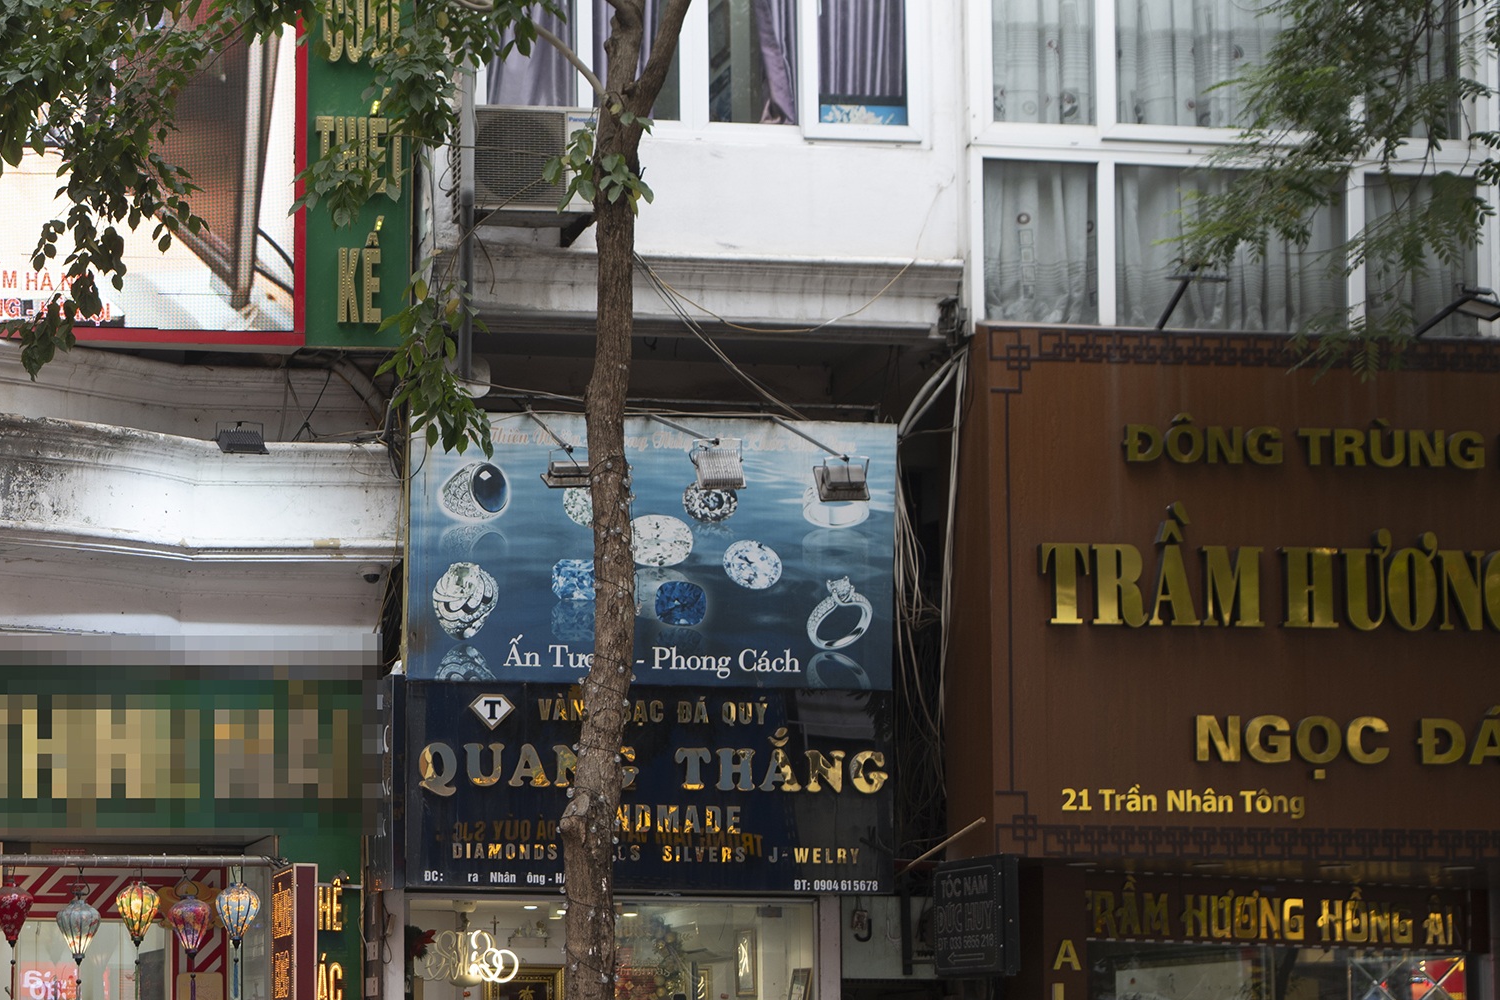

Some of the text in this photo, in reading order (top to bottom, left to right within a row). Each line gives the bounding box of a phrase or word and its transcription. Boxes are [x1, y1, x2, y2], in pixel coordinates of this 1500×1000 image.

[337, 215, 384, 323] KẾ
[1122, 412, 1485, 469] ĐÔNG TRÙNG
[1037, 502, 1265, 629] TRẦM
[503, 635, 541, 668] Ấn
[652, 646, 731, 679] Phong
[738, 648, 801, 674] Cách
[537, 692, 585, 723] VÀN
[677, 694, 707, 725] ĐÁ
[722, 694, 769, 727] QUÝ
[675, 727, 889, 795] THẮNG
[1195, 715, 1390, 779] NGỌC
[1061, 784, 1305, 819] 21 Trần Nhân Tông
[614, 804, 742, 835] NDMADE
[452, 843, 558, 860] DIAMONDS
[662, 845, 746, 863] SILVERS
[768, 847, 860, 864] JWELRY
[423, 870, 444, 883] ĐC:
[489, 871, 517, 884] Nhân
[793, 879, 811, 891] ĐT:
[964, 874, 988, 896] NAM
